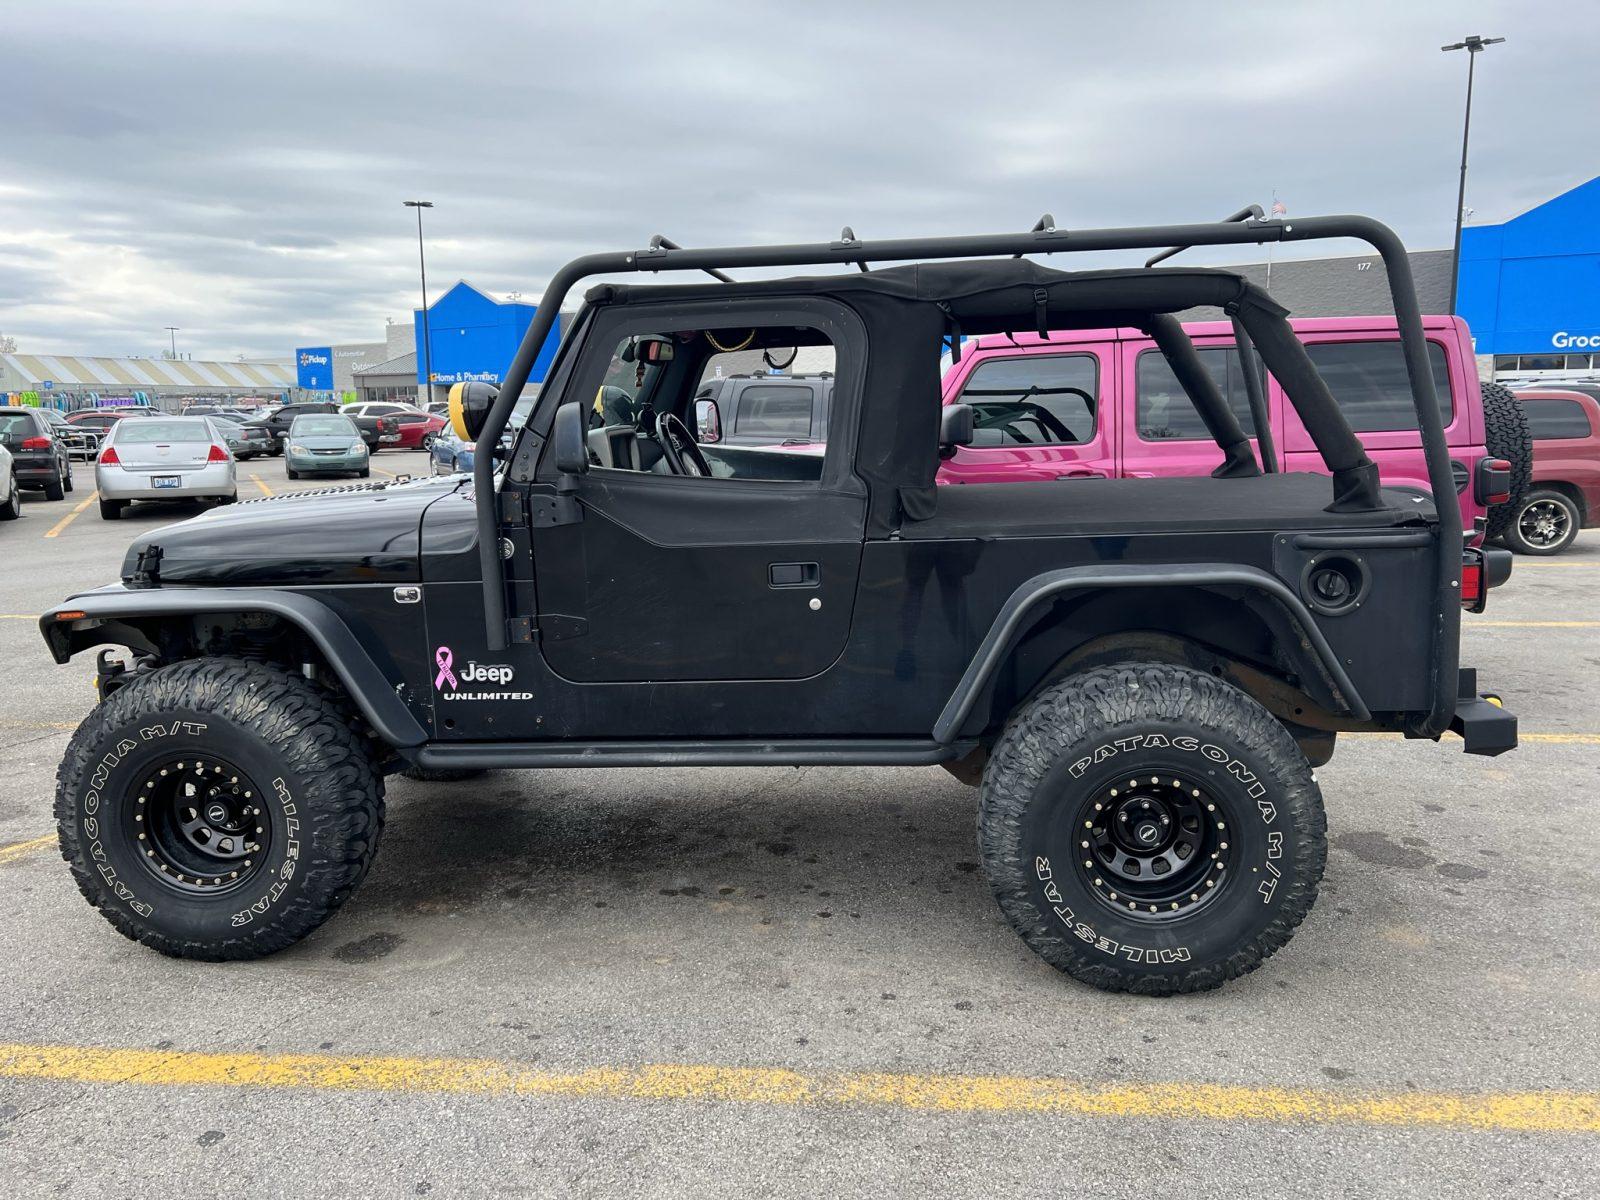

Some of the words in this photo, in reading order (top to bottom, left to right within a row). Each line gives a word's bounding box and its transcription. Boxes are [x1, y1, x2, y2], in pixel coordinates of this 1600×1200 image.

[1358, 262, 1371, 271] 177
[308, 354, 328, 365] Pickup
[436, 373, 455, 382] Home
[460, 661, 514, 685] Jeep
[443, 692, 534, 701] UNLIMITED
[84, 739, 153, 917] PATAGONIA
[140, 721, 207, 740] M/T
[1068, 734, 1277, 824] PATAGONIA
[1258, 832, 1283, 903] M/T
[231, 777, 299, 927] MILESTAR
[1036, 856, 1191, 963] MILESTAR
